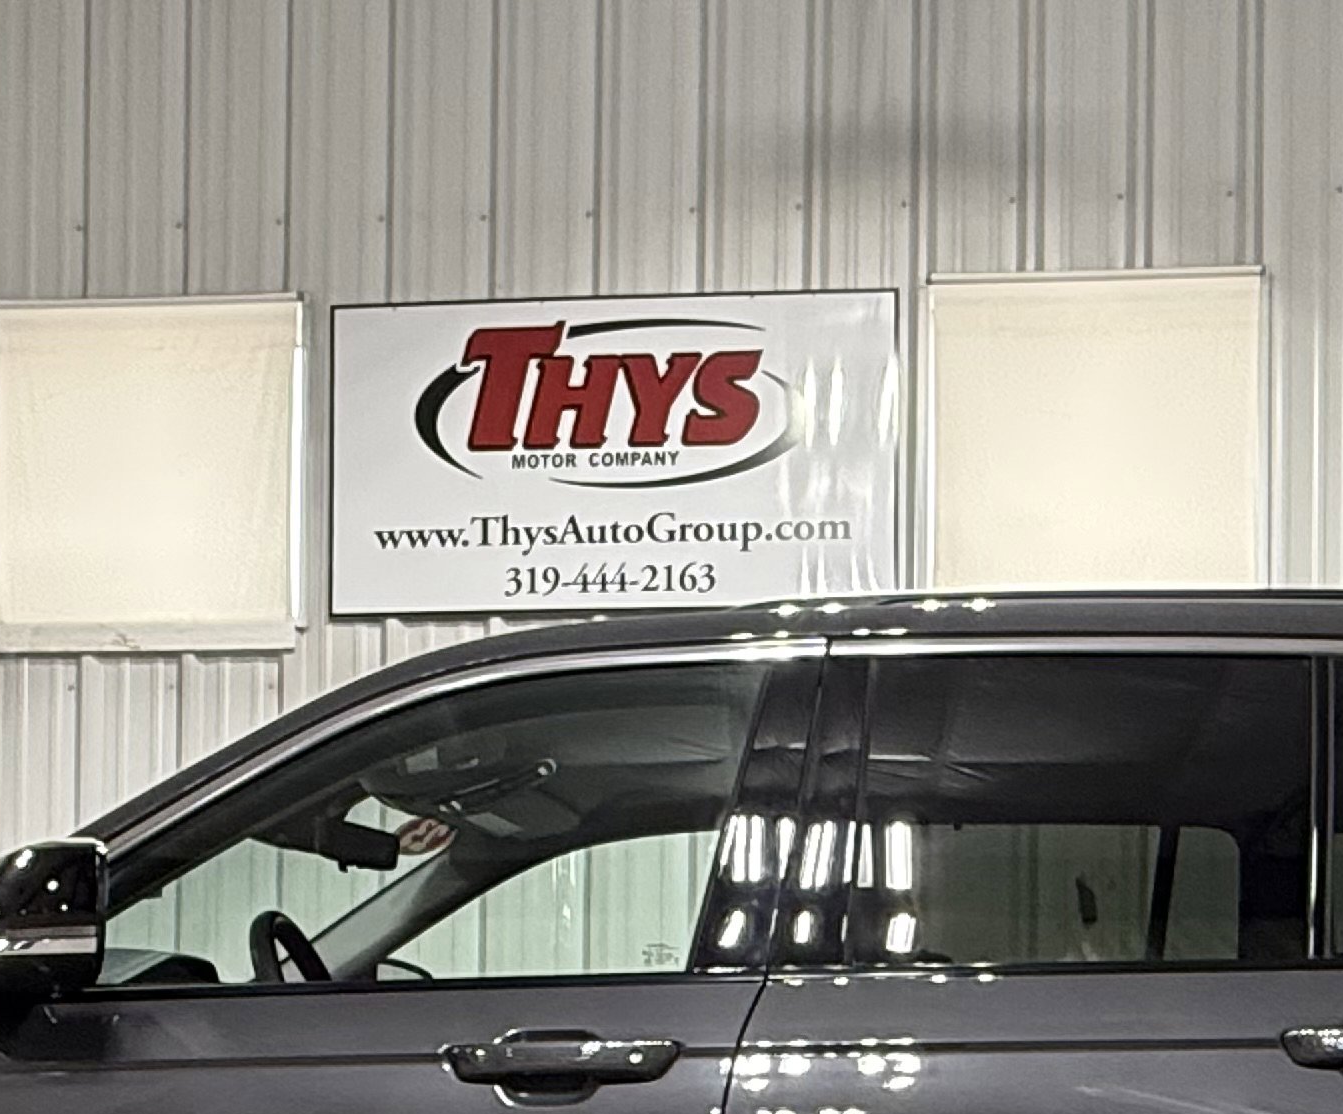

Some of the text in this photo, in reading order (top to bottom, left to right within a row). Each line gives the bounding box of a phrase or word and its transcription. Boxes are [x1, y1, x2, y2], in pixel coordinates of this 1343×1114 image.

[461, 320, 763, 451] THYS
[511, 451, 680, 470] MOTOR COMPANY
[374, 512, 852, 556] www.ThysAutoGroup.com
[504, 562, 717, 597] 319-444-2163
